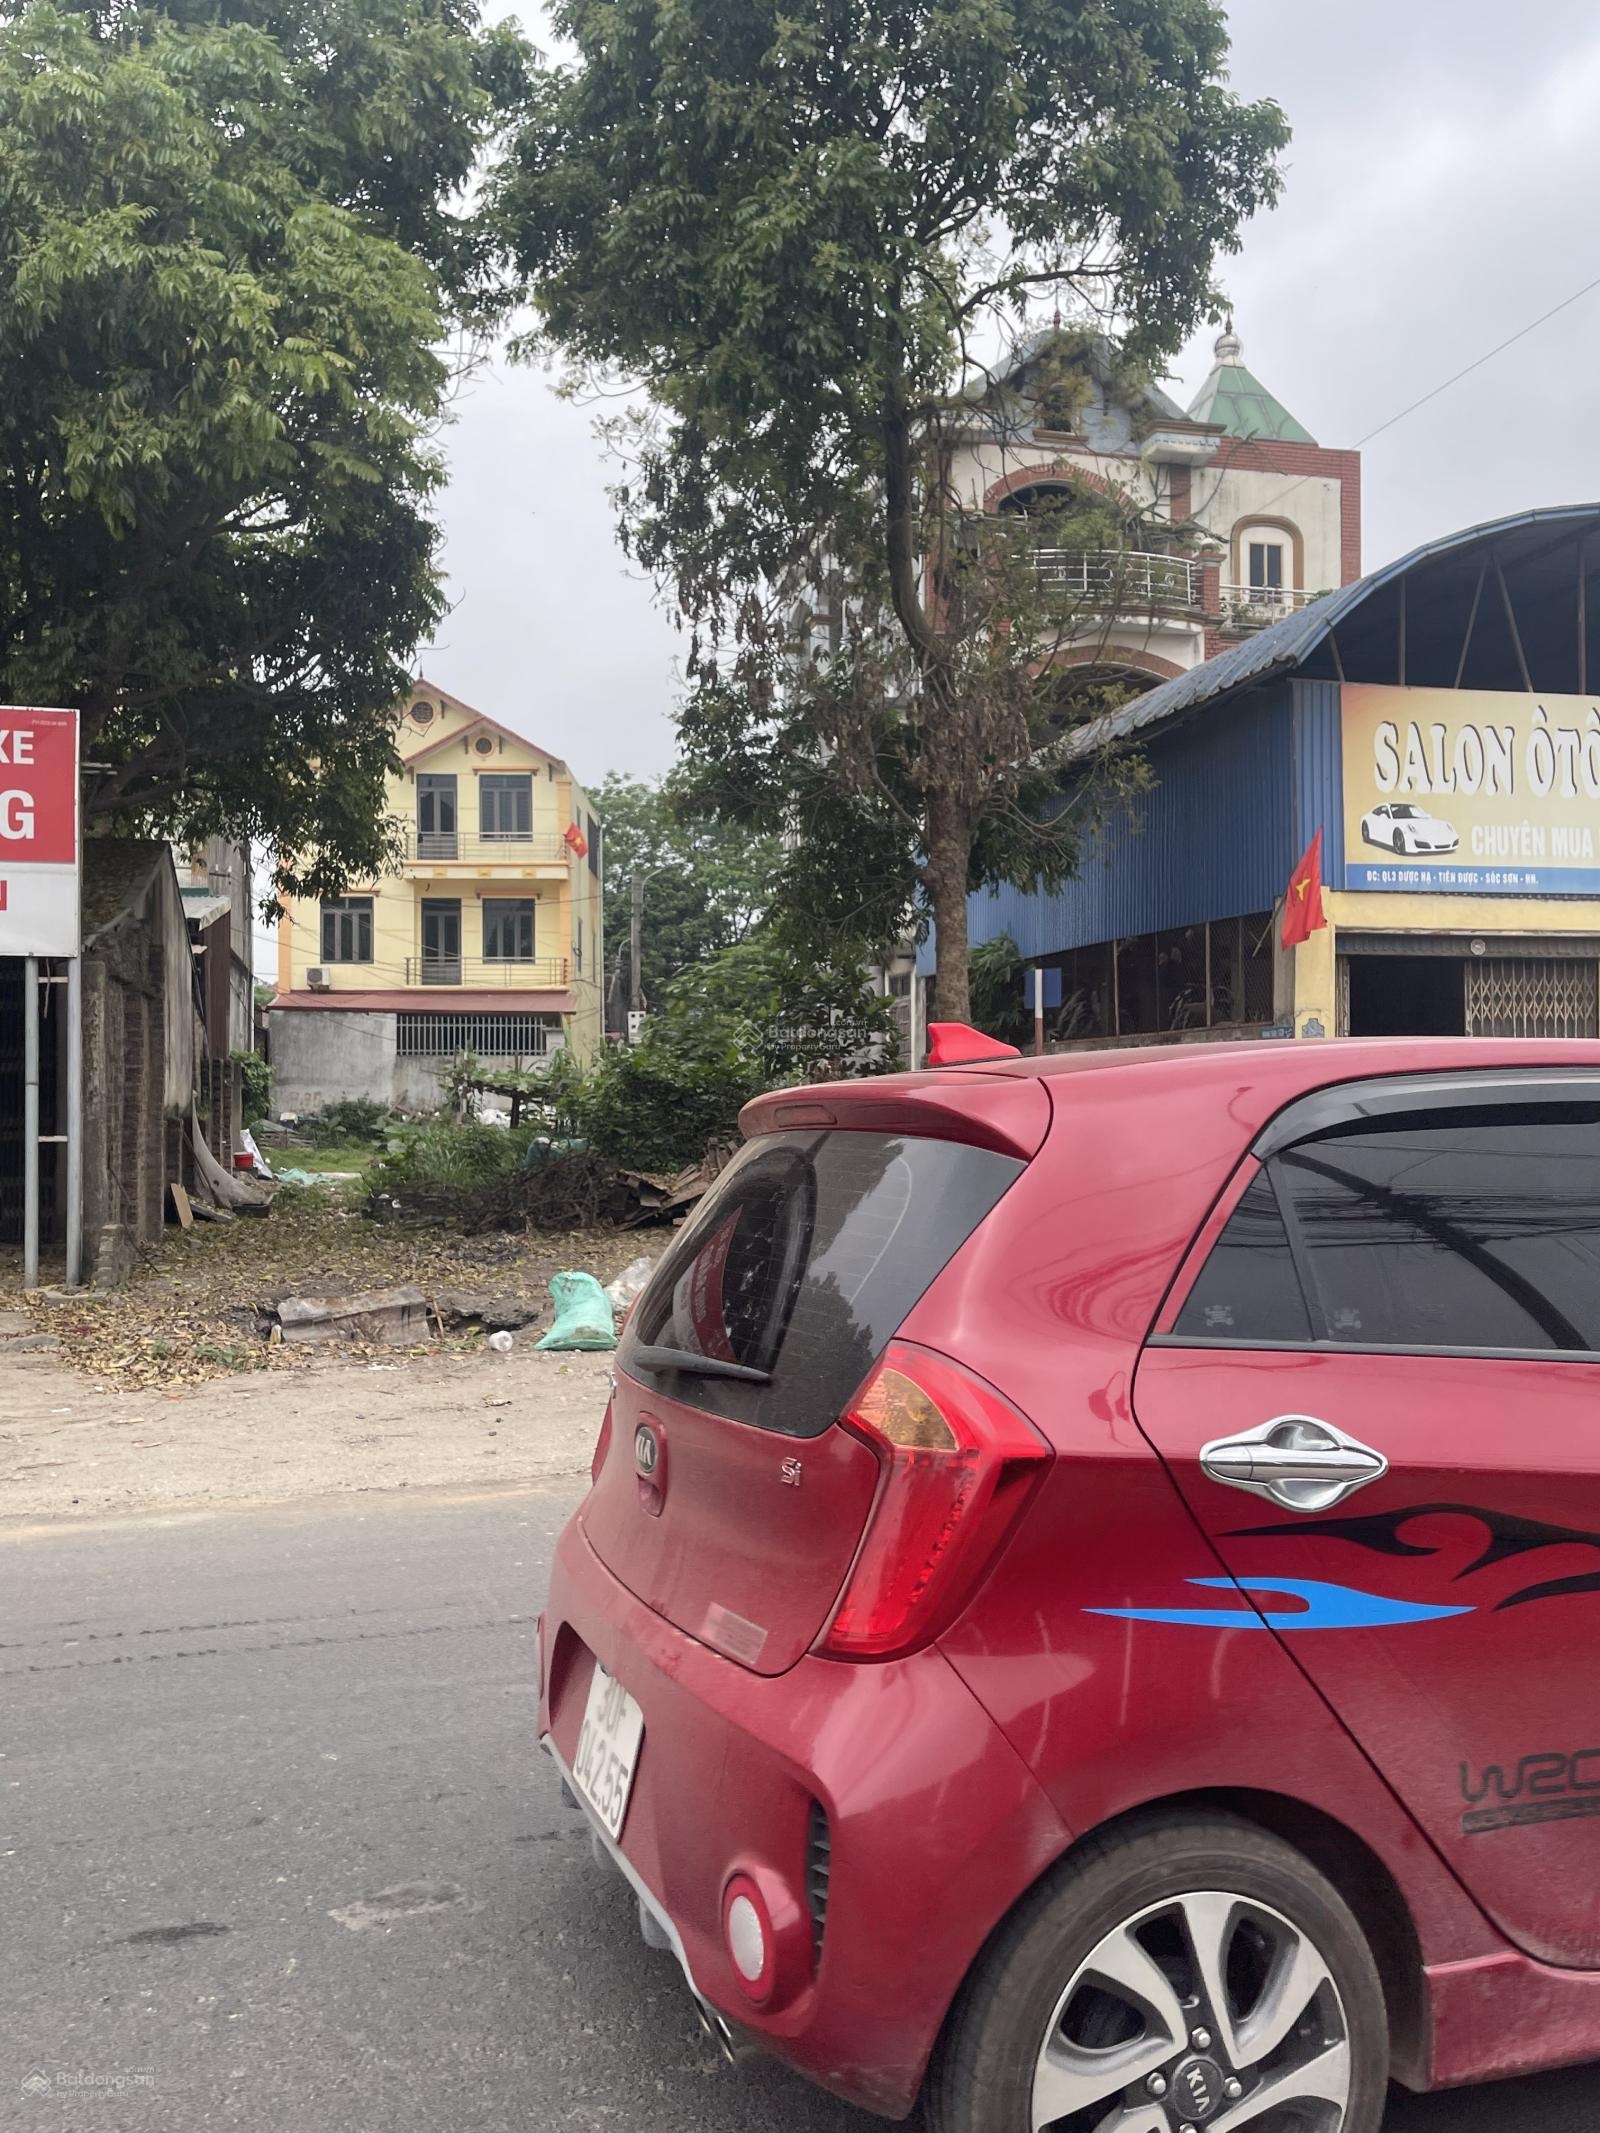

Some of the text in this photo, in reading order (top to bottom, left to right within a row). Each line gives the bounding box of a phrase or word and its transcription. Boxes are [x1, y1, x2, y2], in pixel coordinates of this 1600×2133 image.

[1374, 720, 1515, 796] SALON
[1471, 820, 1594, 858] CHUYÊN MUA
[781, 1456, 801, 1487] Si
[1186, 2067, 1210, 2113] KIA
